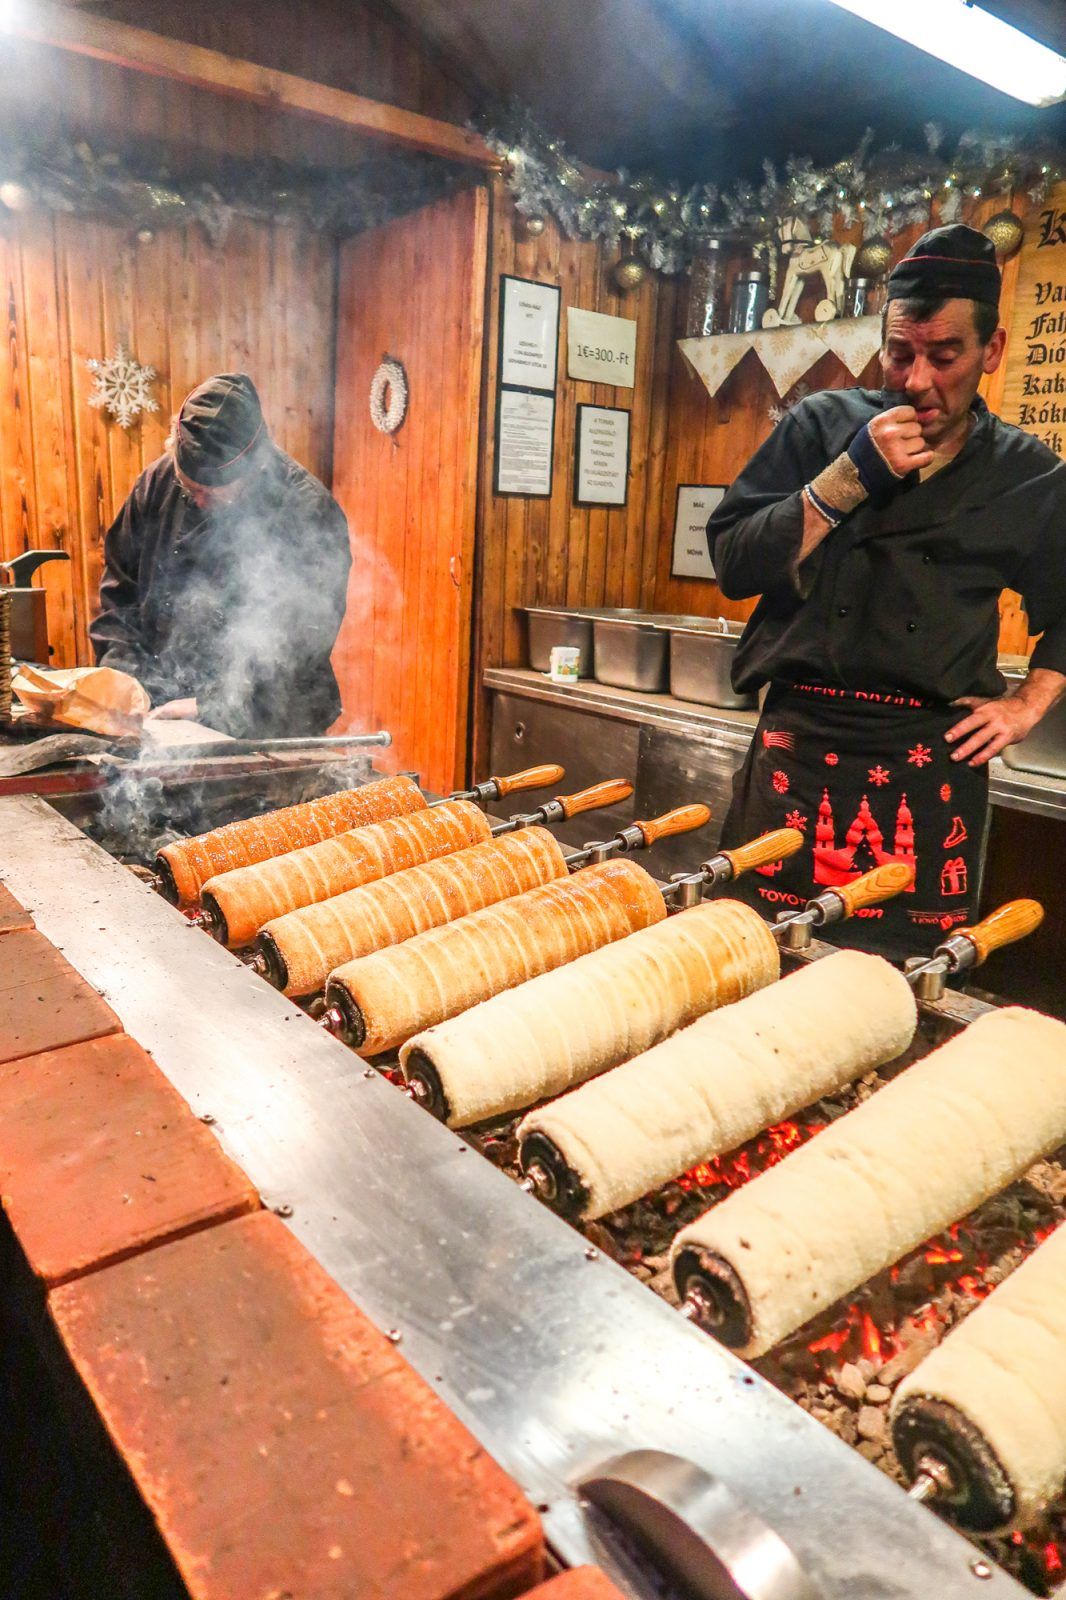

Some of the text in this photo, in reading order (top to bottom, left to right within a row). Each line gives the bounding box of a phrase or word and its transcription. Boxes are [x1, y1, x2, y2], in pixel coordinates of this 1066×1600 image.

[1034, 281, 1066, 305] Va
[1023, 372, 1066, 396] Kak
[758, 887, 808, 906] TOYOT
